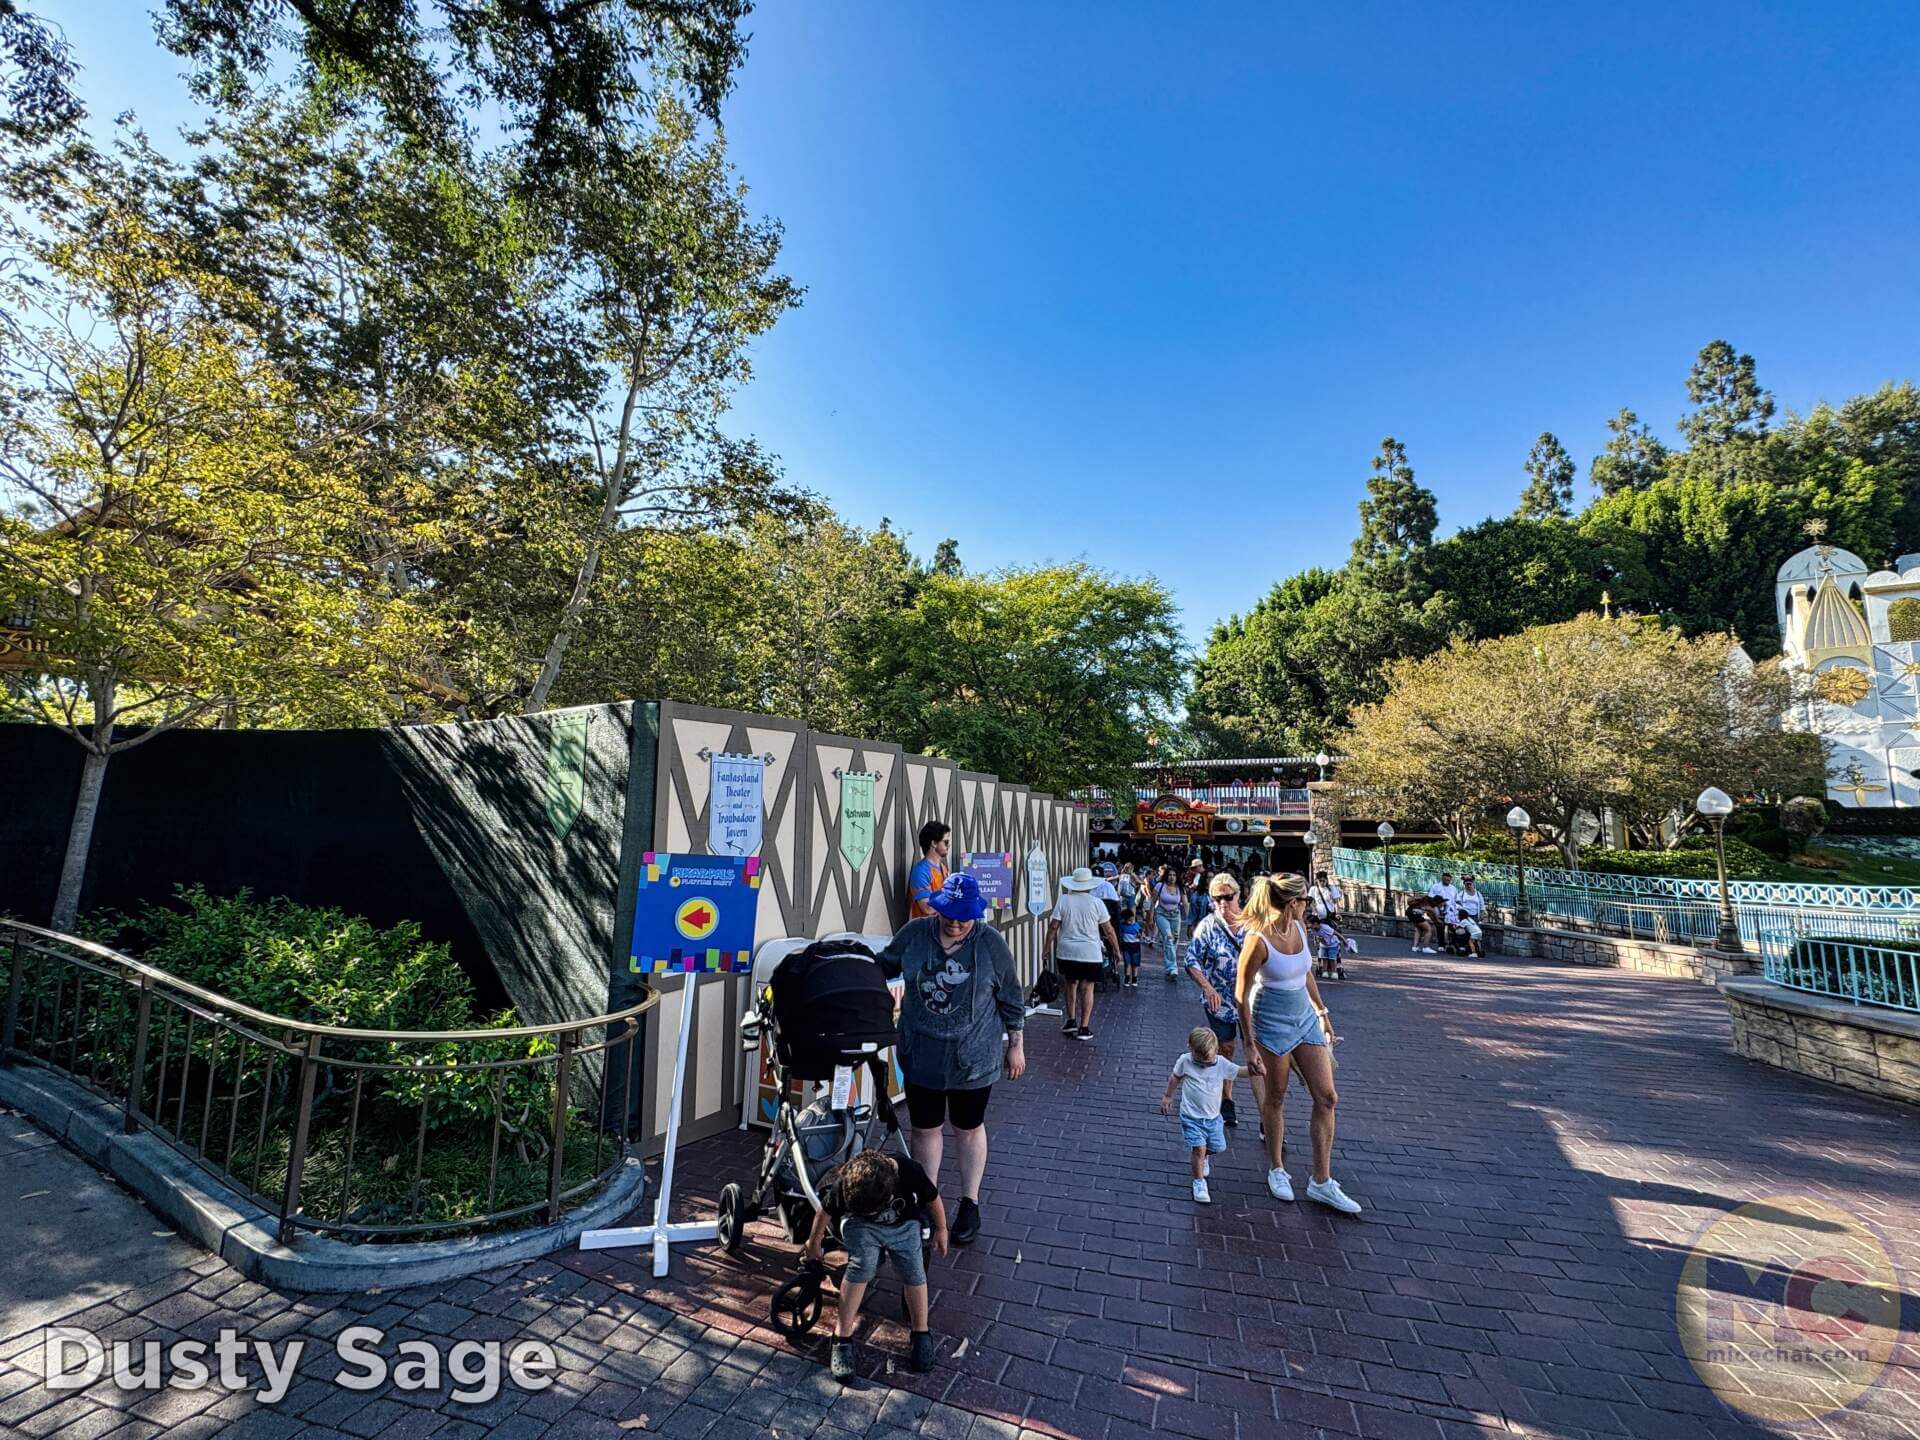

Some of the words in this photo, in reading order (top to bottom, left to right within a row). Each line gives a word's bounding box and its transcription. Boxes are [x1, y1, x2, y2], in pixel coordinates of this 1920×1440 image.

[717, 771, 759, 785] Fantasyland
[732, 801, 742, 809] and
[718, 812, 756, 824] Troubadour
[845, 807, 871, 819] Restrooms
[726, 826, 747, 838] Tavern
